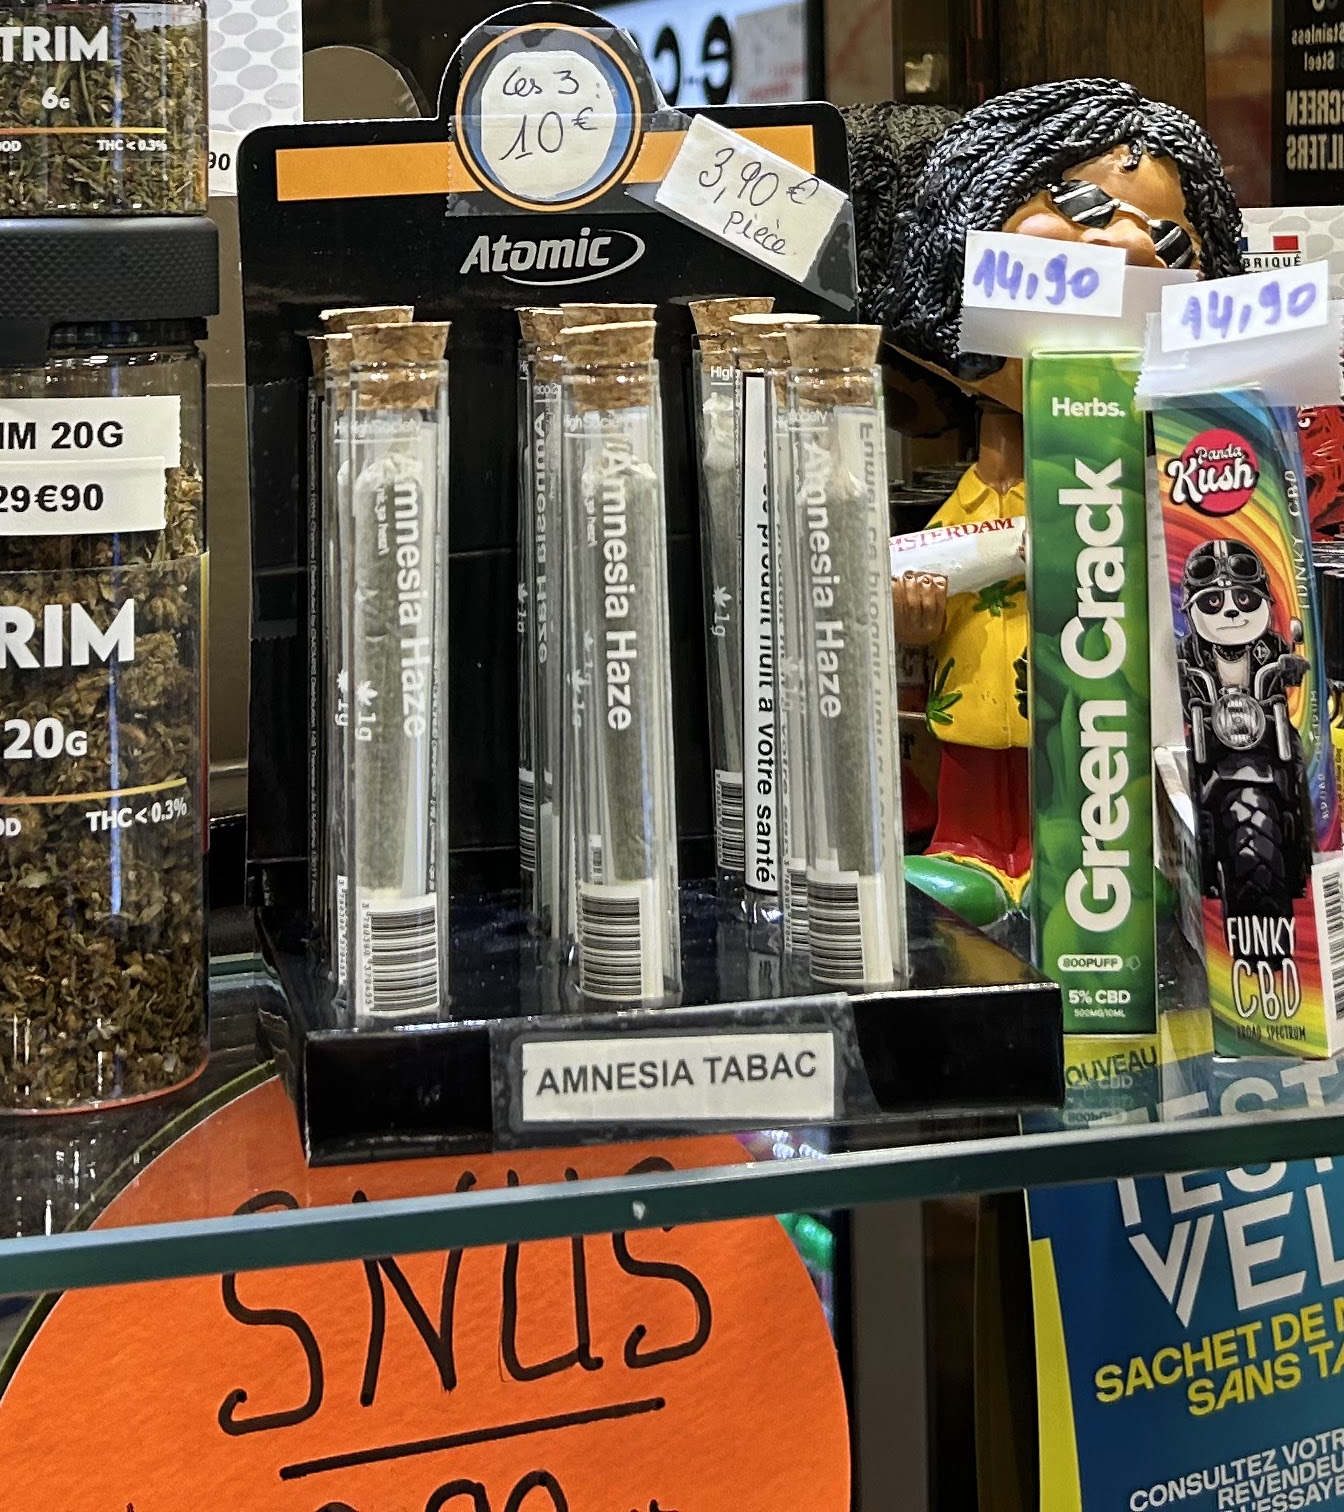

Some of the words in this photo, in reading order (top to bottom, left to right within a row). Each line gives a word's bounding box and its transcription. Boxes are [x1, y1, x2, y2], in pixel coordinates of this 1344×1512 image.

[41, 86, 70, 111] 6G
[97, 138, 124, 151] THC
[137, 139, 167, 153] 0.3%
[460, 226, 611, 274] Atomic
[971, 248, 1100, 305] 14,90
[1181, 280, 1317, 340] 14,90
[1051, 397, 1126, 418] Herbs.
[51, 421, 124, 449] 20G
[1195, 443, 1244, 464] Panda
[1167, 456, 1258, 504] Kush
[600, 445, 635, 618] Amnesia
[802, 441, 839, 610] Amnesia
[1058, 457, 1128, 680] Crack
[605, 630, 639, 731] Haze
[812, 620, 844, 719] Haze
[4, 718, 88, 759] 20G
[86, 807, 133, 832] THC
[151, 797, 187, 823] 0.3%
[1065, 699, 1132, 933] Green
[1227, 916, 1296, 956] FUNKY
[1068, 989, 1092, 1005] 5%
[1095, 989, 1131, 1004] CBD
[1231, 959, 1301, 1020] CBD
[535, 1058, 696, 1098] AMNESIA
[703, 1049, 819, 1087] TABAC
[1094, 1321, 1262, 1404] SACHET
[1272, 1304, 1323, 1346] DE
[1186, 1353, 1302, 1417] SANS
[1129, 1450, 1276, 1512] CONSULTEZ
